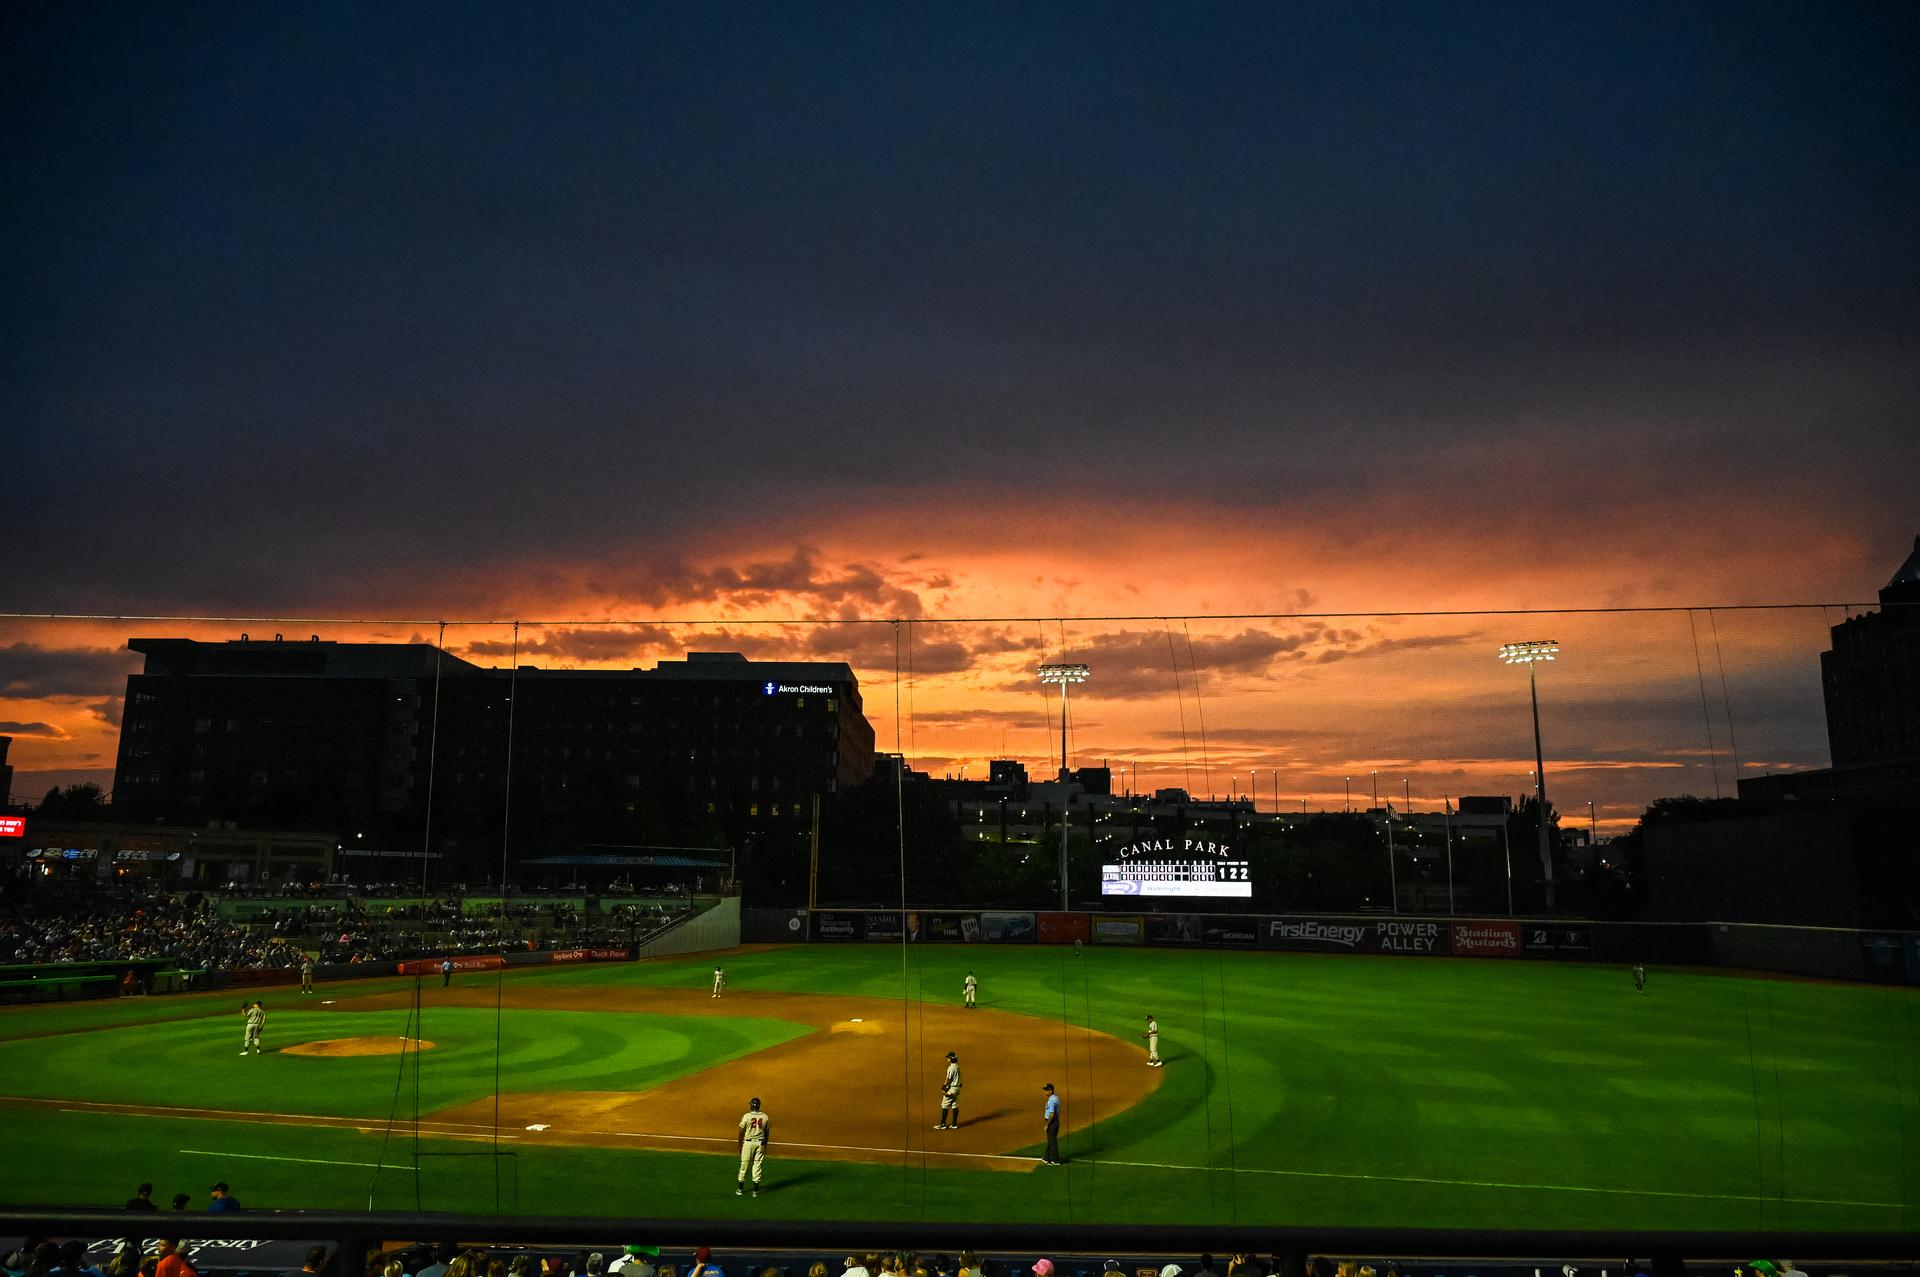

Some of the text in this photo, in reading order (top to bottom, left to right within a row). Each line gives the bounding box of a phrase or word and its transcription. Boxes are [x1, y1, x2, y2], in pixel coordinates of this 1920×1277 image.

[778, 684, 832, 694] Akron Children's
[1120, 839, 1230, 858] CANAL PARK
[1220, 868, 1248, 880] 1 2 2
[820, 926, 854, 934] Authority
[1270, 920, 1366, 942] FirstEnergy
[1377, 922, 1438, 937] POWER
[1456, 926, 1515, 939] Stadium
[1381, 937, 1435, 951] ALLEY
[1456, 936, 1516, 948] Mustard
